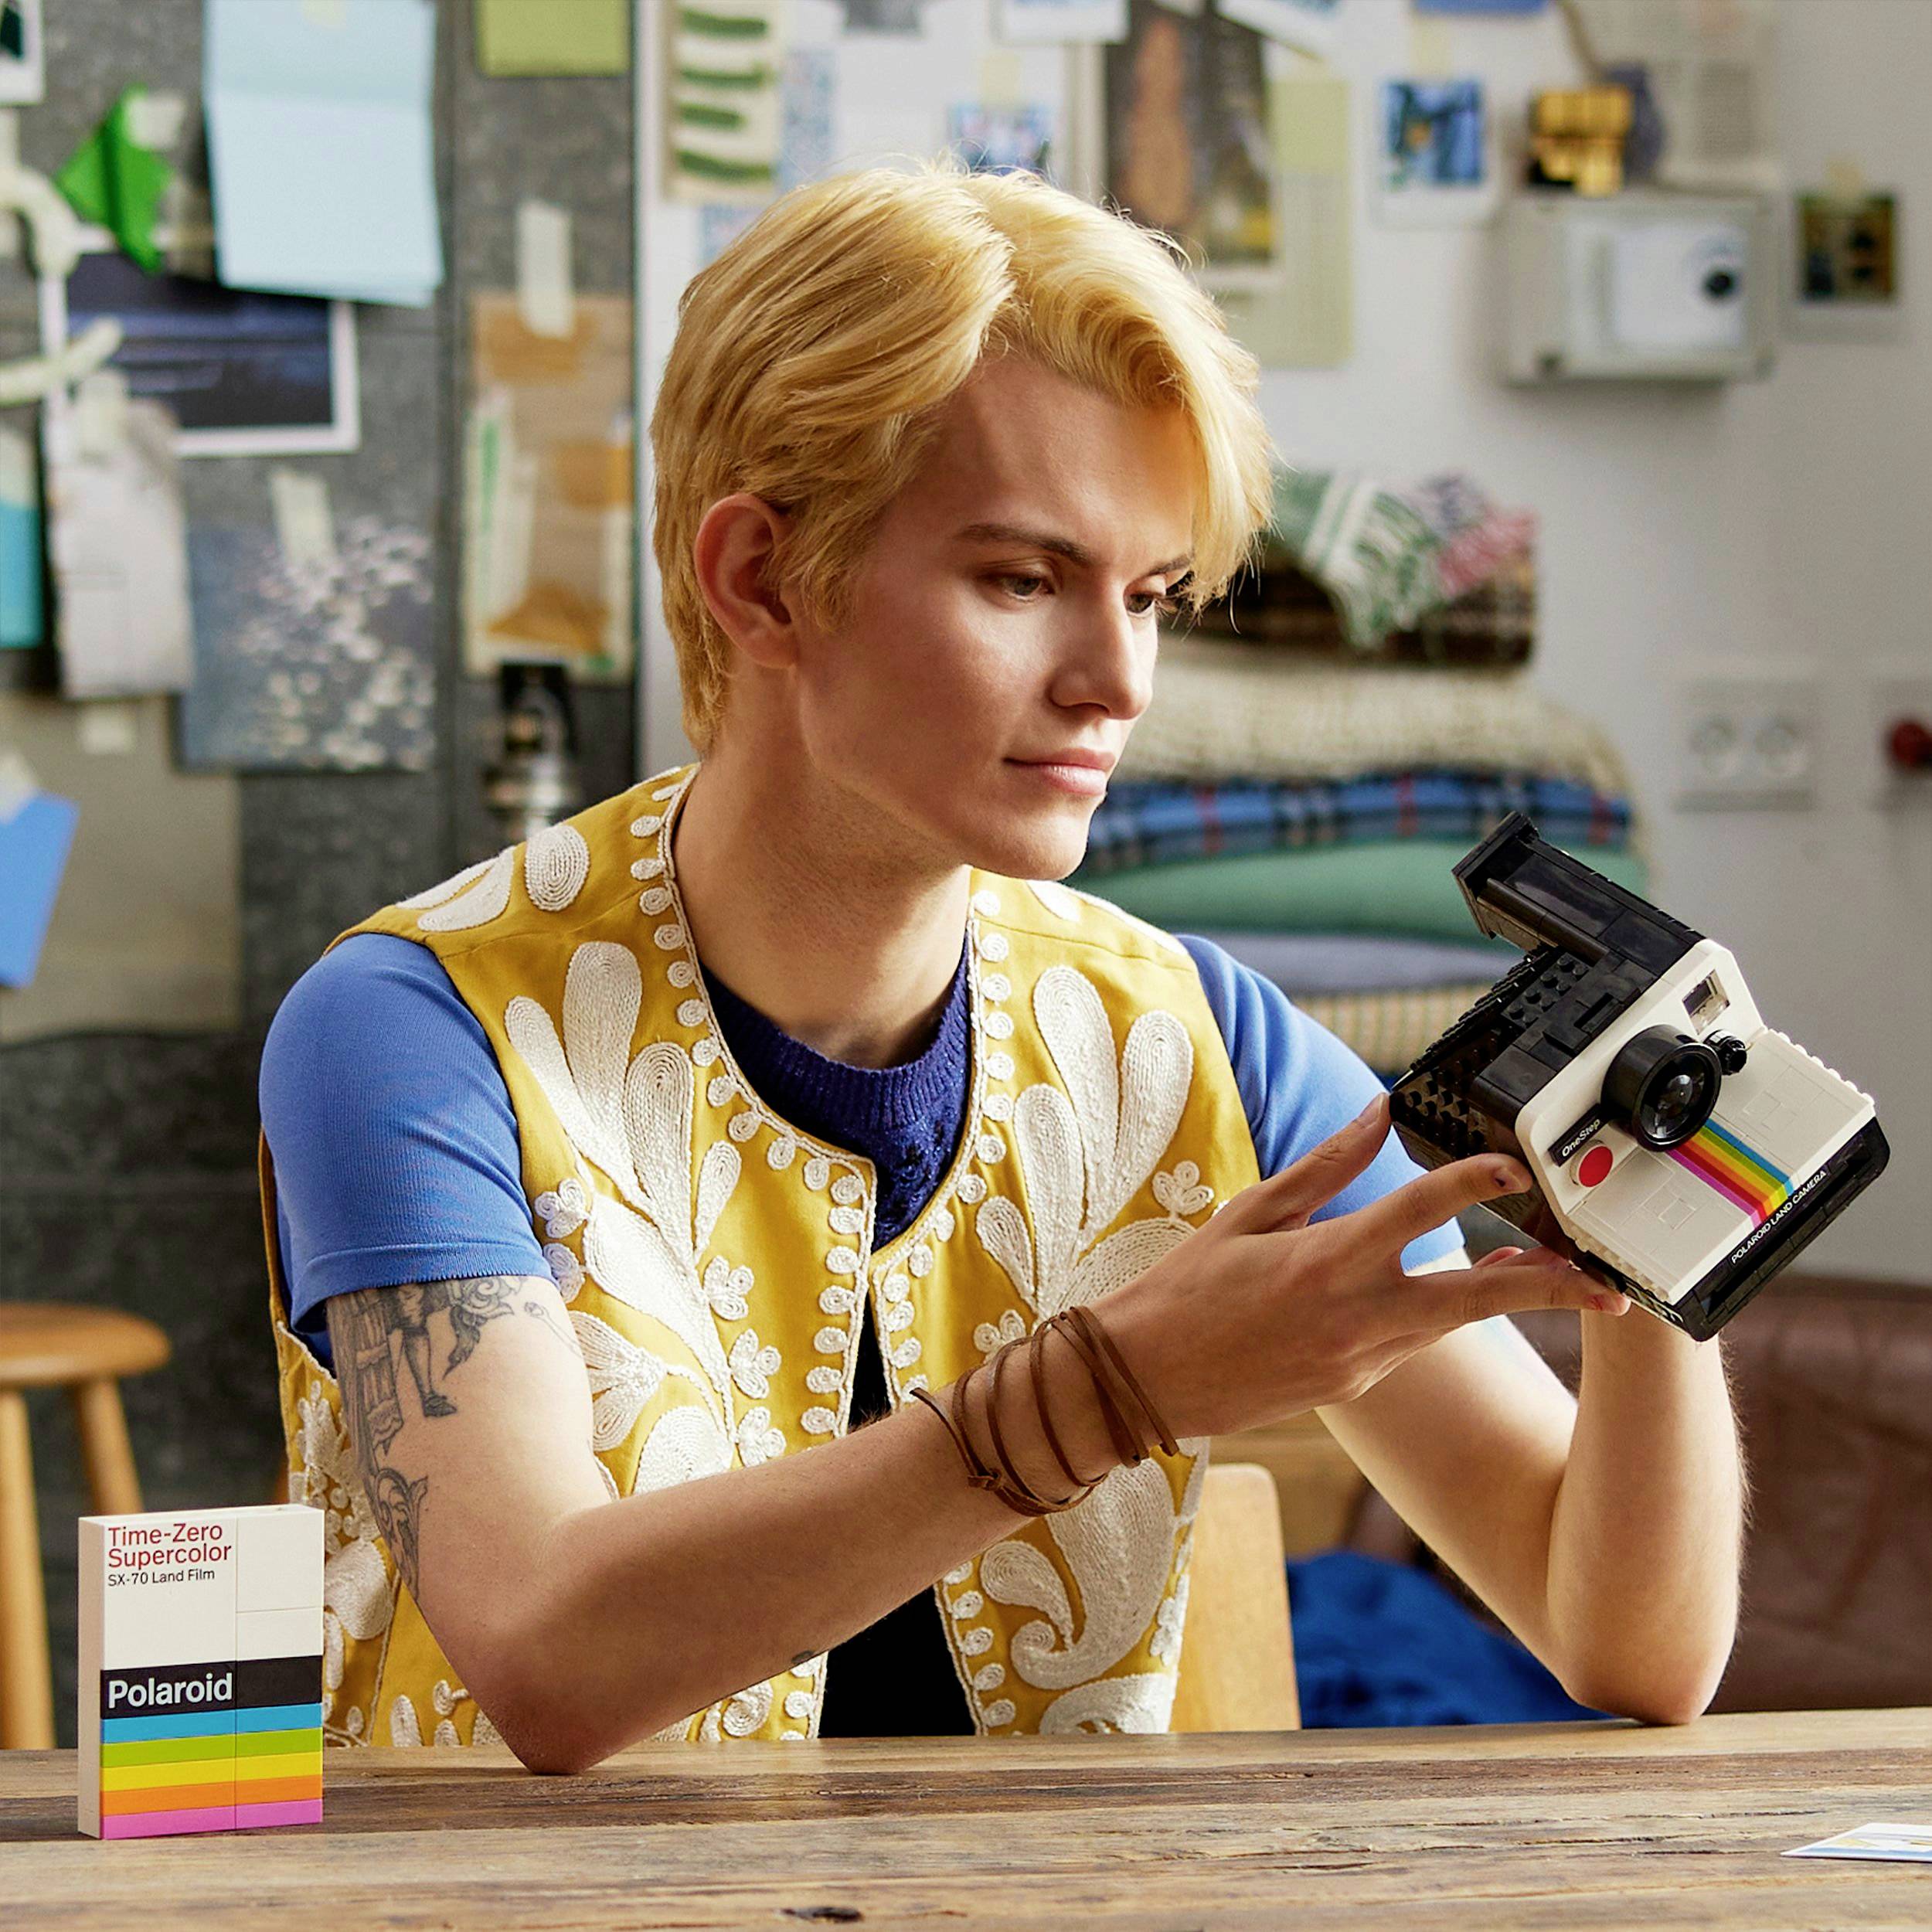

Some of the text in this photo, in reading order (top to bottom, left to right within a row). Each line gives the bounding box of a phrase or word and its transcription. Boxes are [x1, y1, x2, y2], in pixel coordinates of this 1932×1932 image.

[1561, 1118, 1600, 1157] OneStep
[1731, 1170, 1827, 1264] POLAROID LAND CAMERA
[107, 1523, 223, 1546] Time-Zero
[108, 1543, 232, 1570] Supercolor
[108, 1568, 215, 1587] SX-70 Land Film
[107, 1672, 233, 1709] Polaroid
